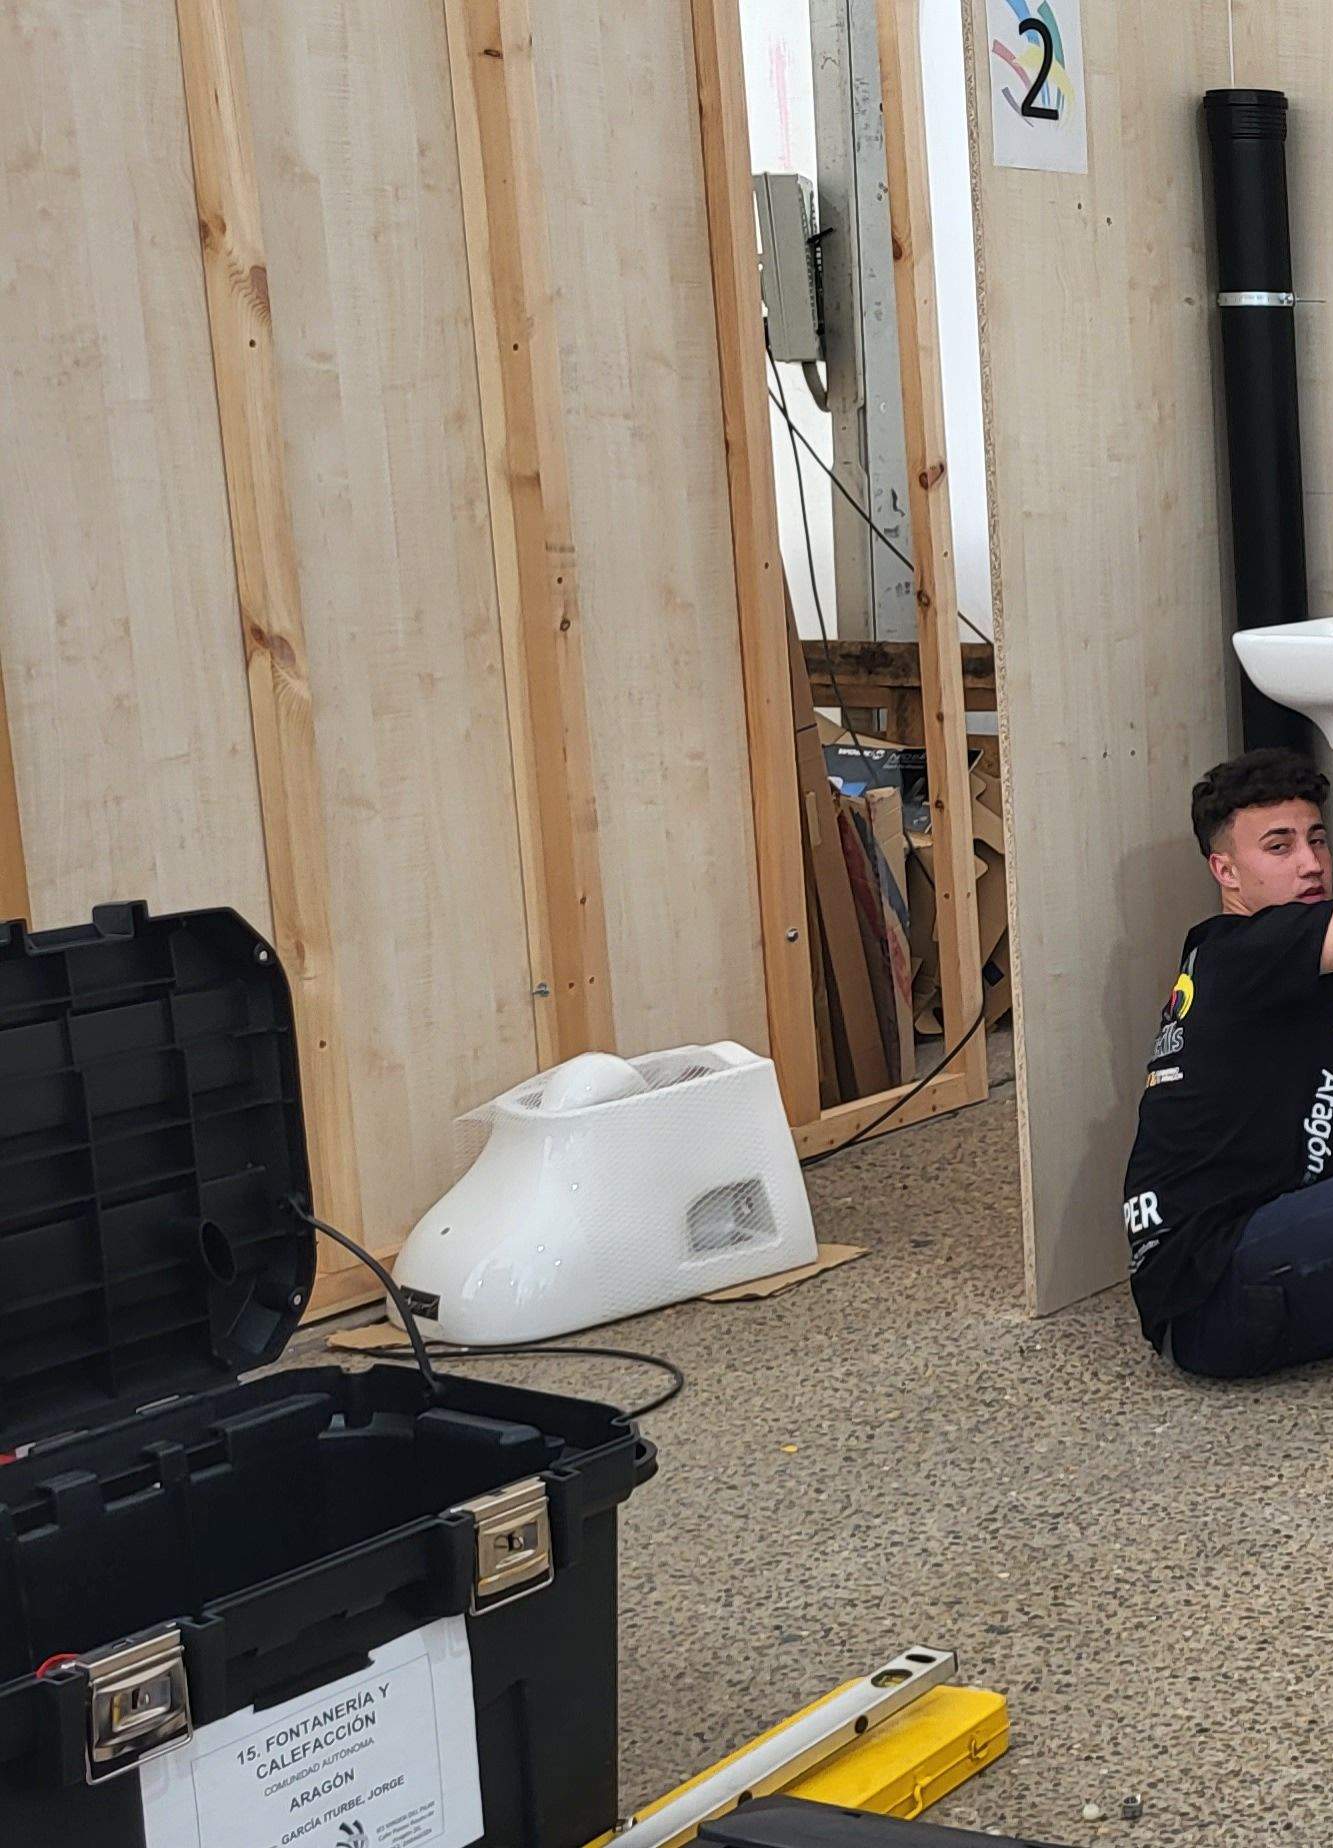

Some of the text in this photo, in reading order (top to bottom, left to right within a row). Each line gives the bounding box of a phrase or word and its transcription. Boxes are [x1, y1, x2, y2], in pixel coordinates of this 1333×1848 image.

[1019, 18, 1059, 120] 2
[236, 1683, 390, 1765] 15. FONTANERÍA Y
[256, 1711, 377, 1779] CALEFACCIÓN
[264, 1763, 320, 1797] COMUNIDAD
[281, 1818, 322, 1845] GARCÍA
[368, 1774, 405, 1800] JORGE
[289, 1768, 355, 1812] ARAGÓN
